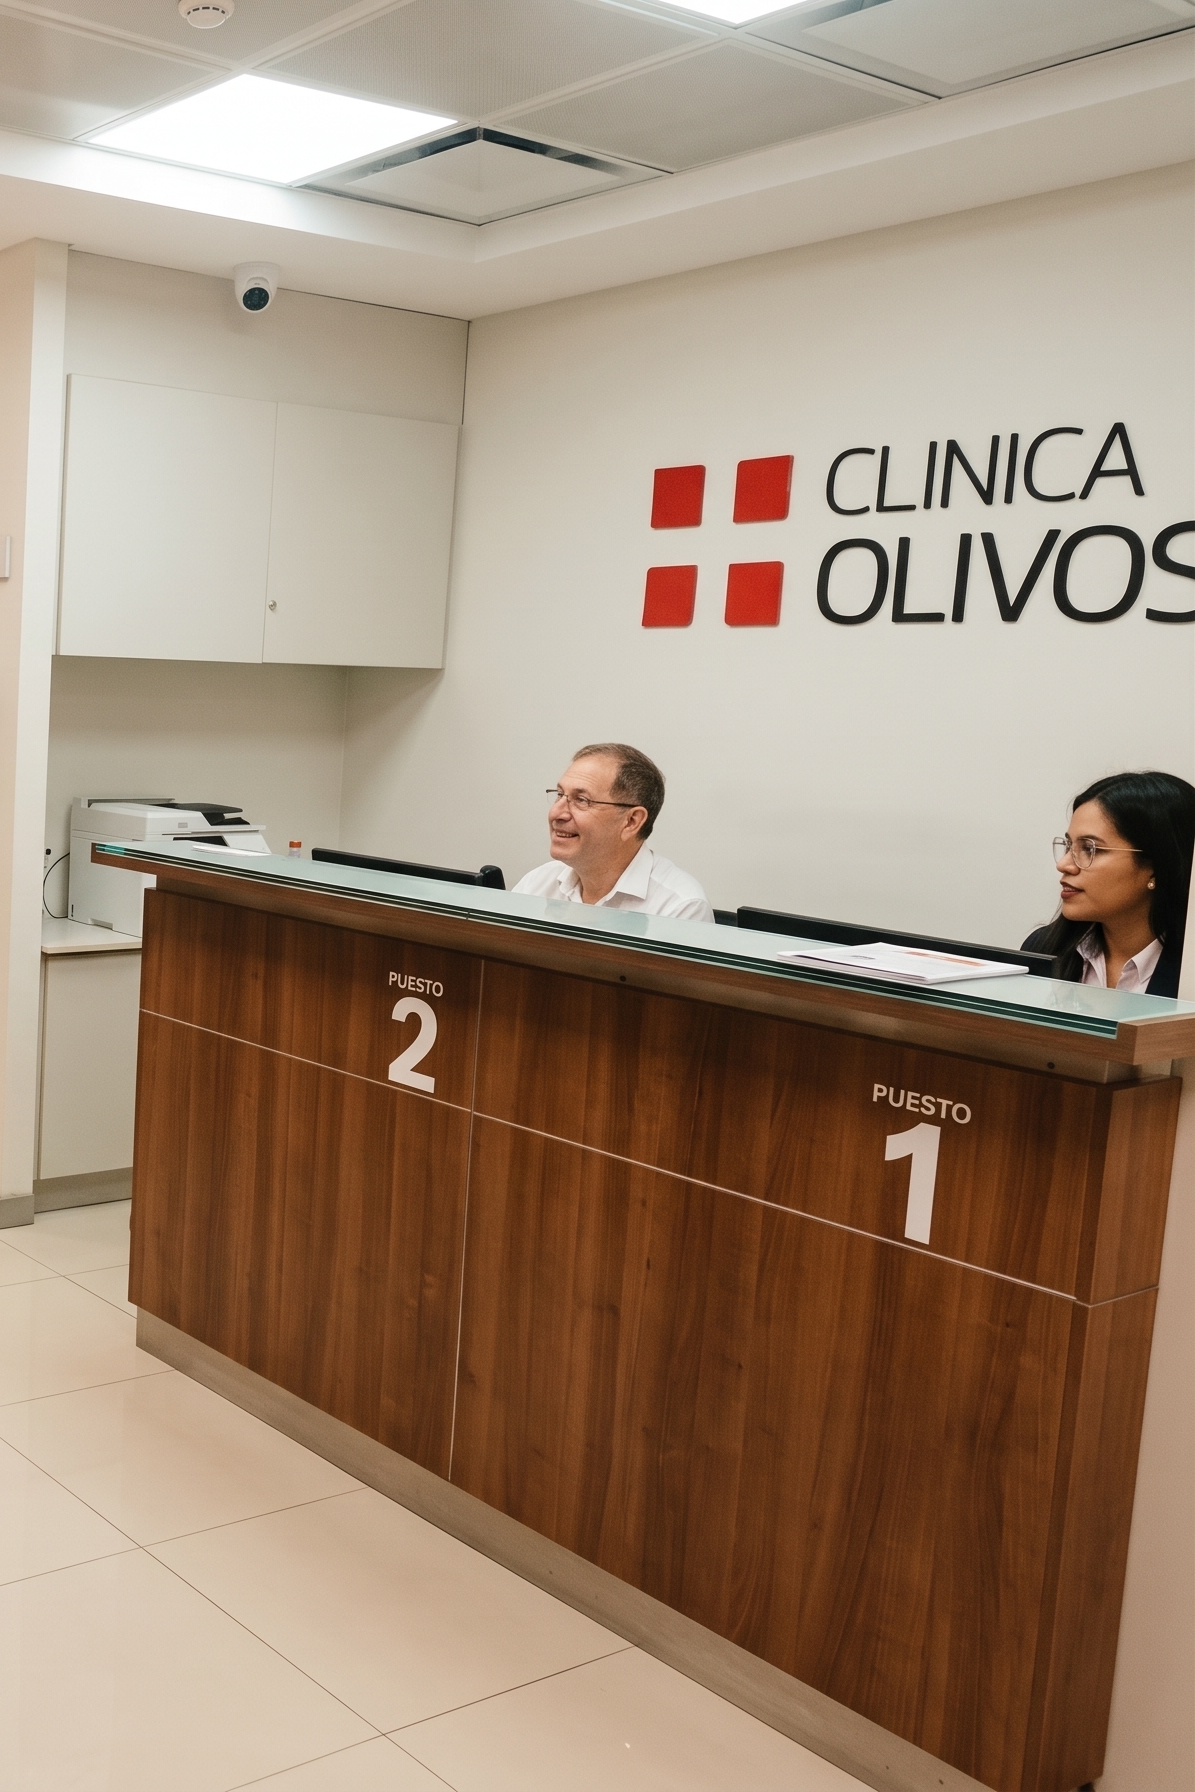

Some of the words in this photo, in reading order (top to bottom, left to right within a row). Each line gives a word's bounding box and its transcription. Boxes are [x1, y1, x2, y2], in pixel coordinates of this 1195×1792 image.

[825, 421, 1145, 516] CLINICA
[816, 520, 1195, 625] OLIVOS
[388, 971, 444, 997] PUESTO
[388, 996, 438, 1094] 2
[872, 1083, 972, 1124] PUESTO
[884, 1122, 941, 1245] 1
